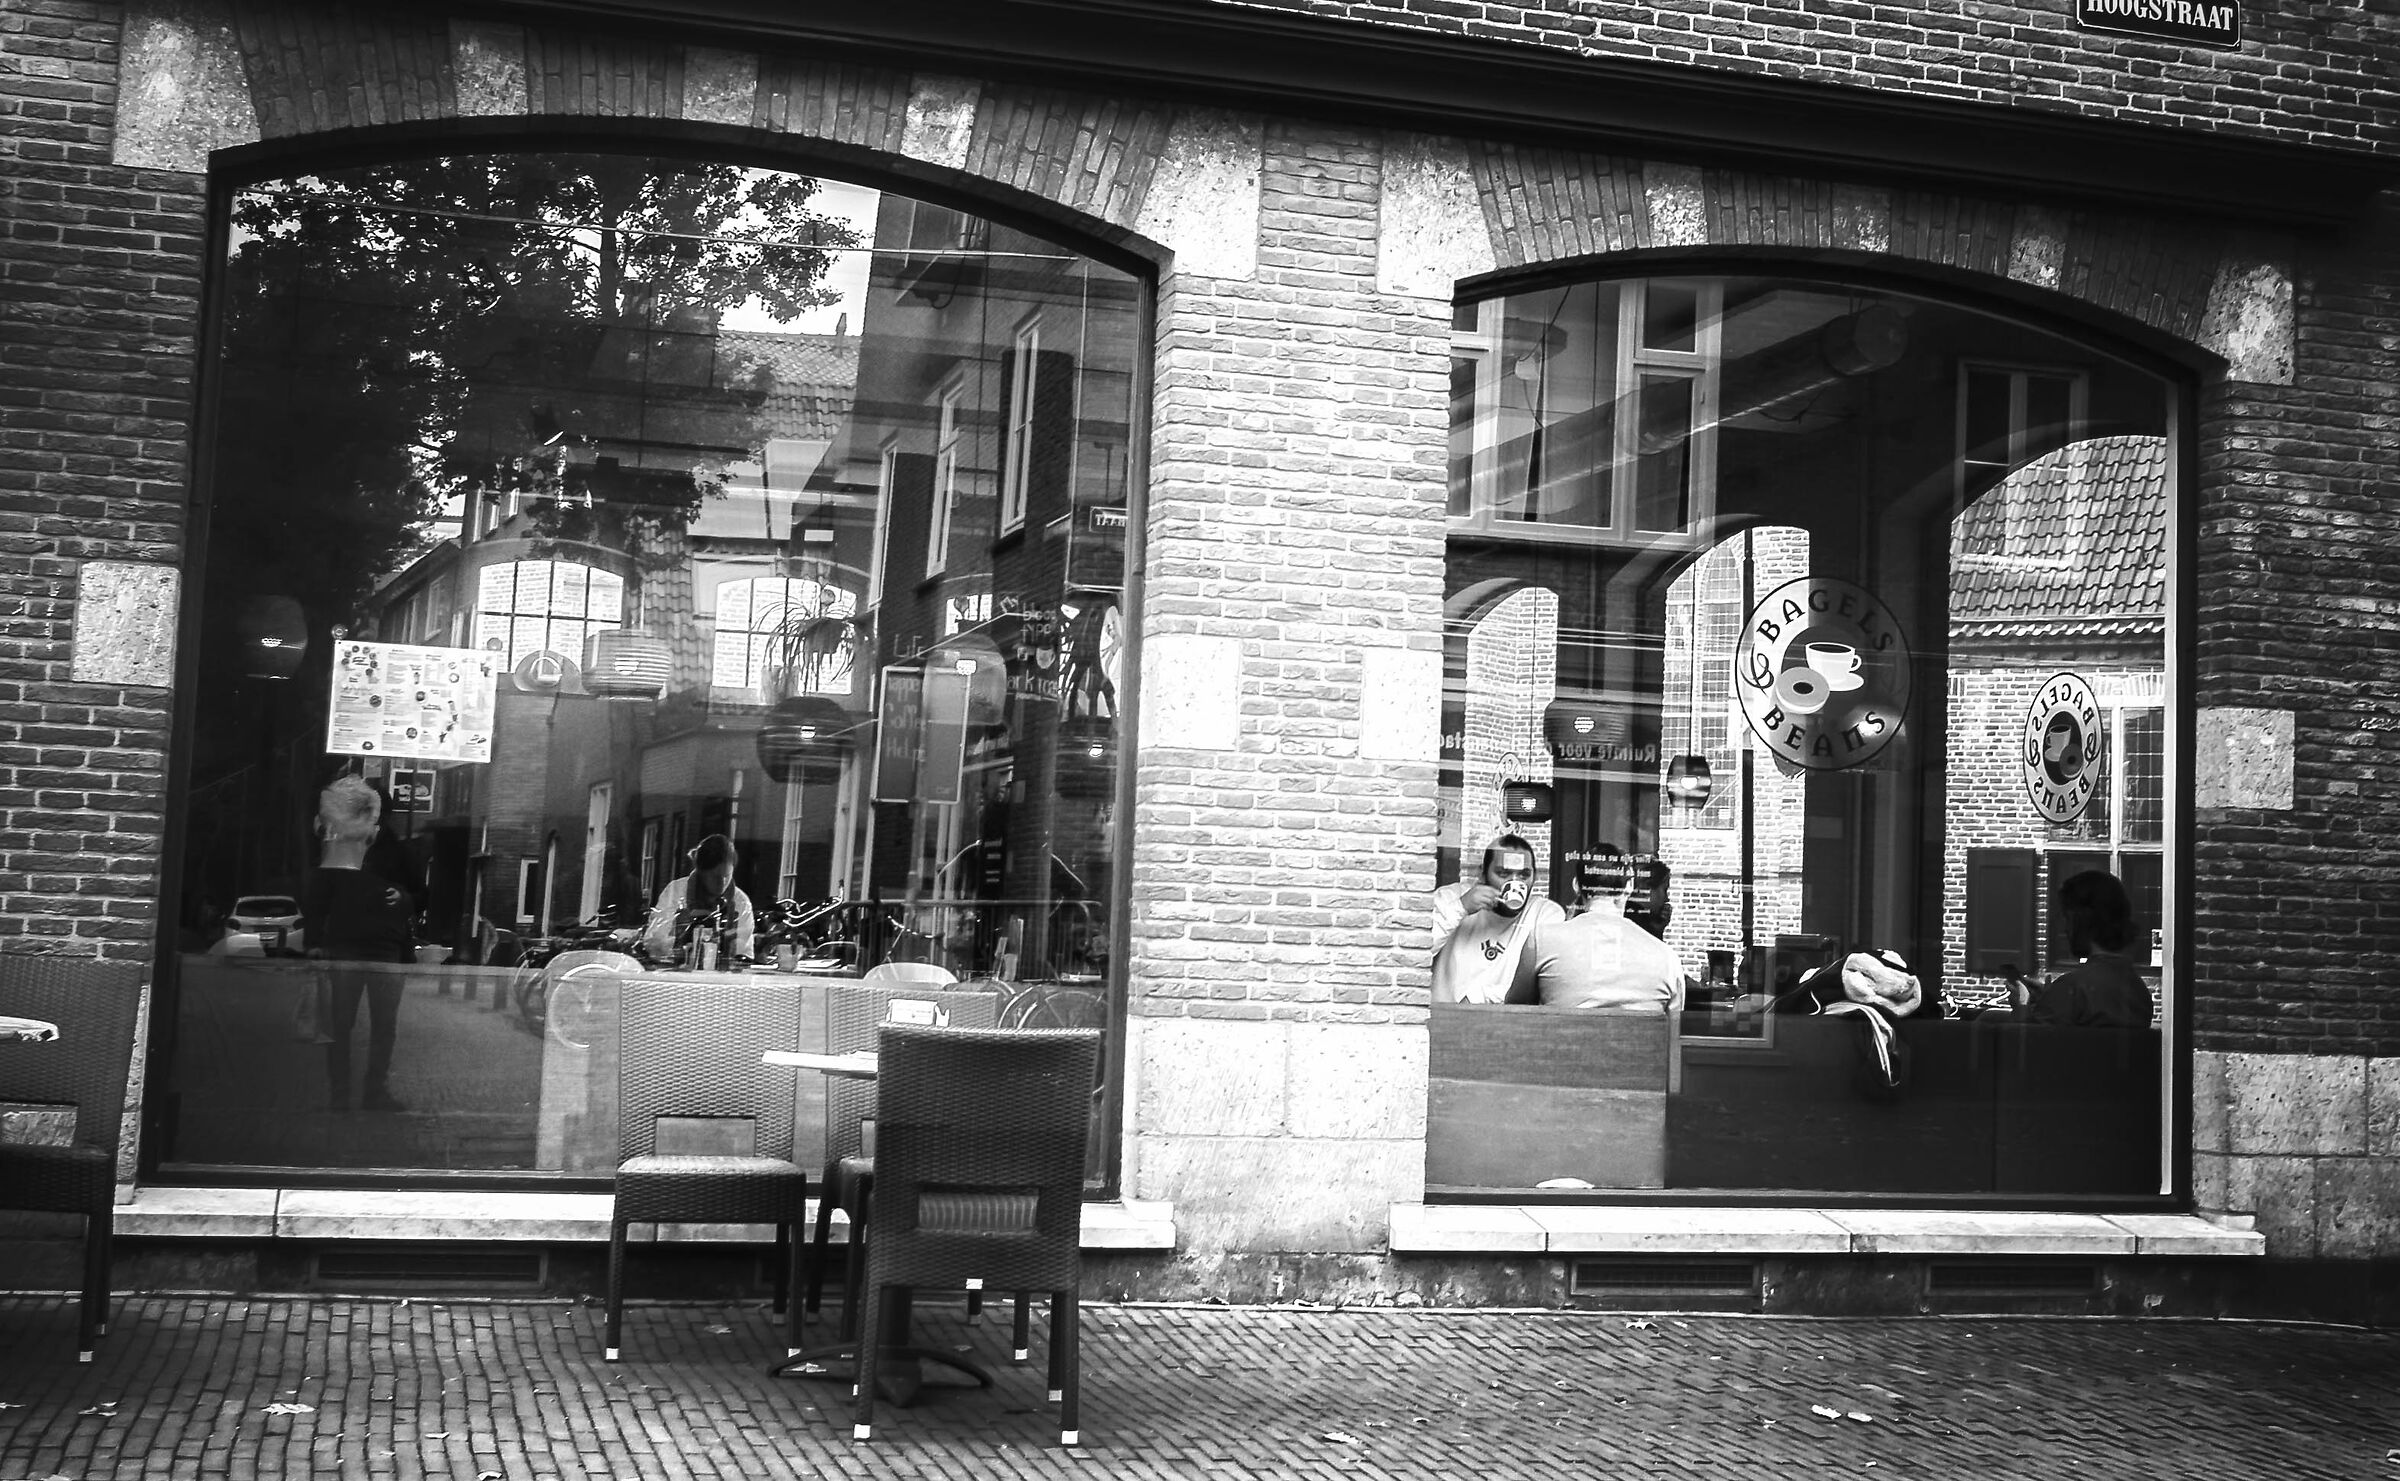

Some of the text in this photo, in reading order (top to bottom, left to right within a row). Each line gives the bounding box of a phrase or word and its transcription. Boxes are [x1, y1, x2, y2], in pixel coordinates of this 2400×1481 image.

[2086, 0, 2233, 31] HOOGSTRAAT
[1756, 589, 1894, 652] BAGELS
[1761, 705, 1886, 758] BEANS
